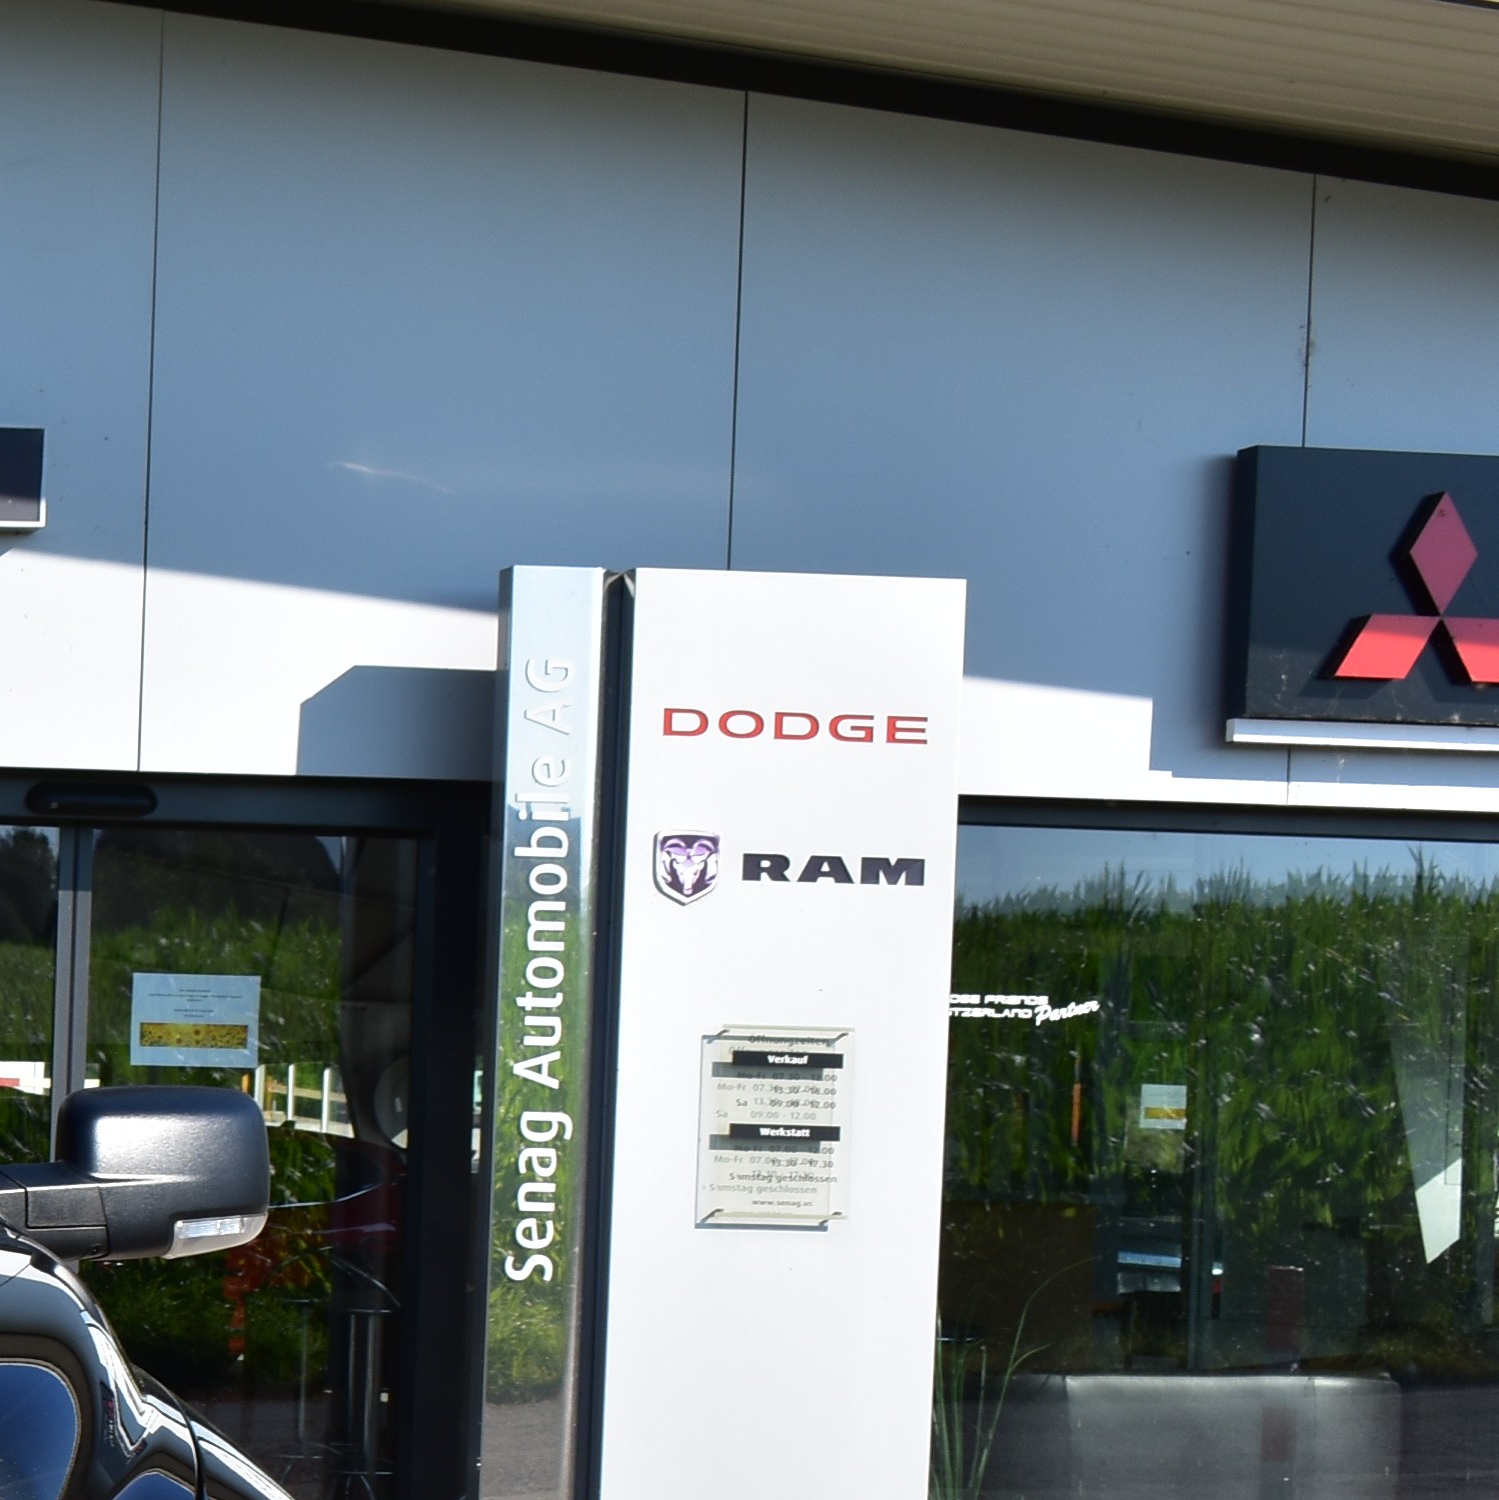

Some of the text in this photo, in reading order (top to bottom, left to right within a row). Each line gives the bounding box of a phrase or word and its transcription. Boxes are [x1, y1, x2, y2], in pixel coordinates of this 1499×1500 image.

[662, 707, 928, 745] DODGE
[741, 852, 926, 886] RAM
[505, 659, 575, 1282] Senag Automobile AG
[1034, 1000, 1101, 1026] Partner
[767, 1054, 809, 1065] Verkauf
[735, 1099, 748, 1107] Sa
[759, 1127, 811, 1138] Werkstatt
[775, 1173, 838, 1183] geschlossen
